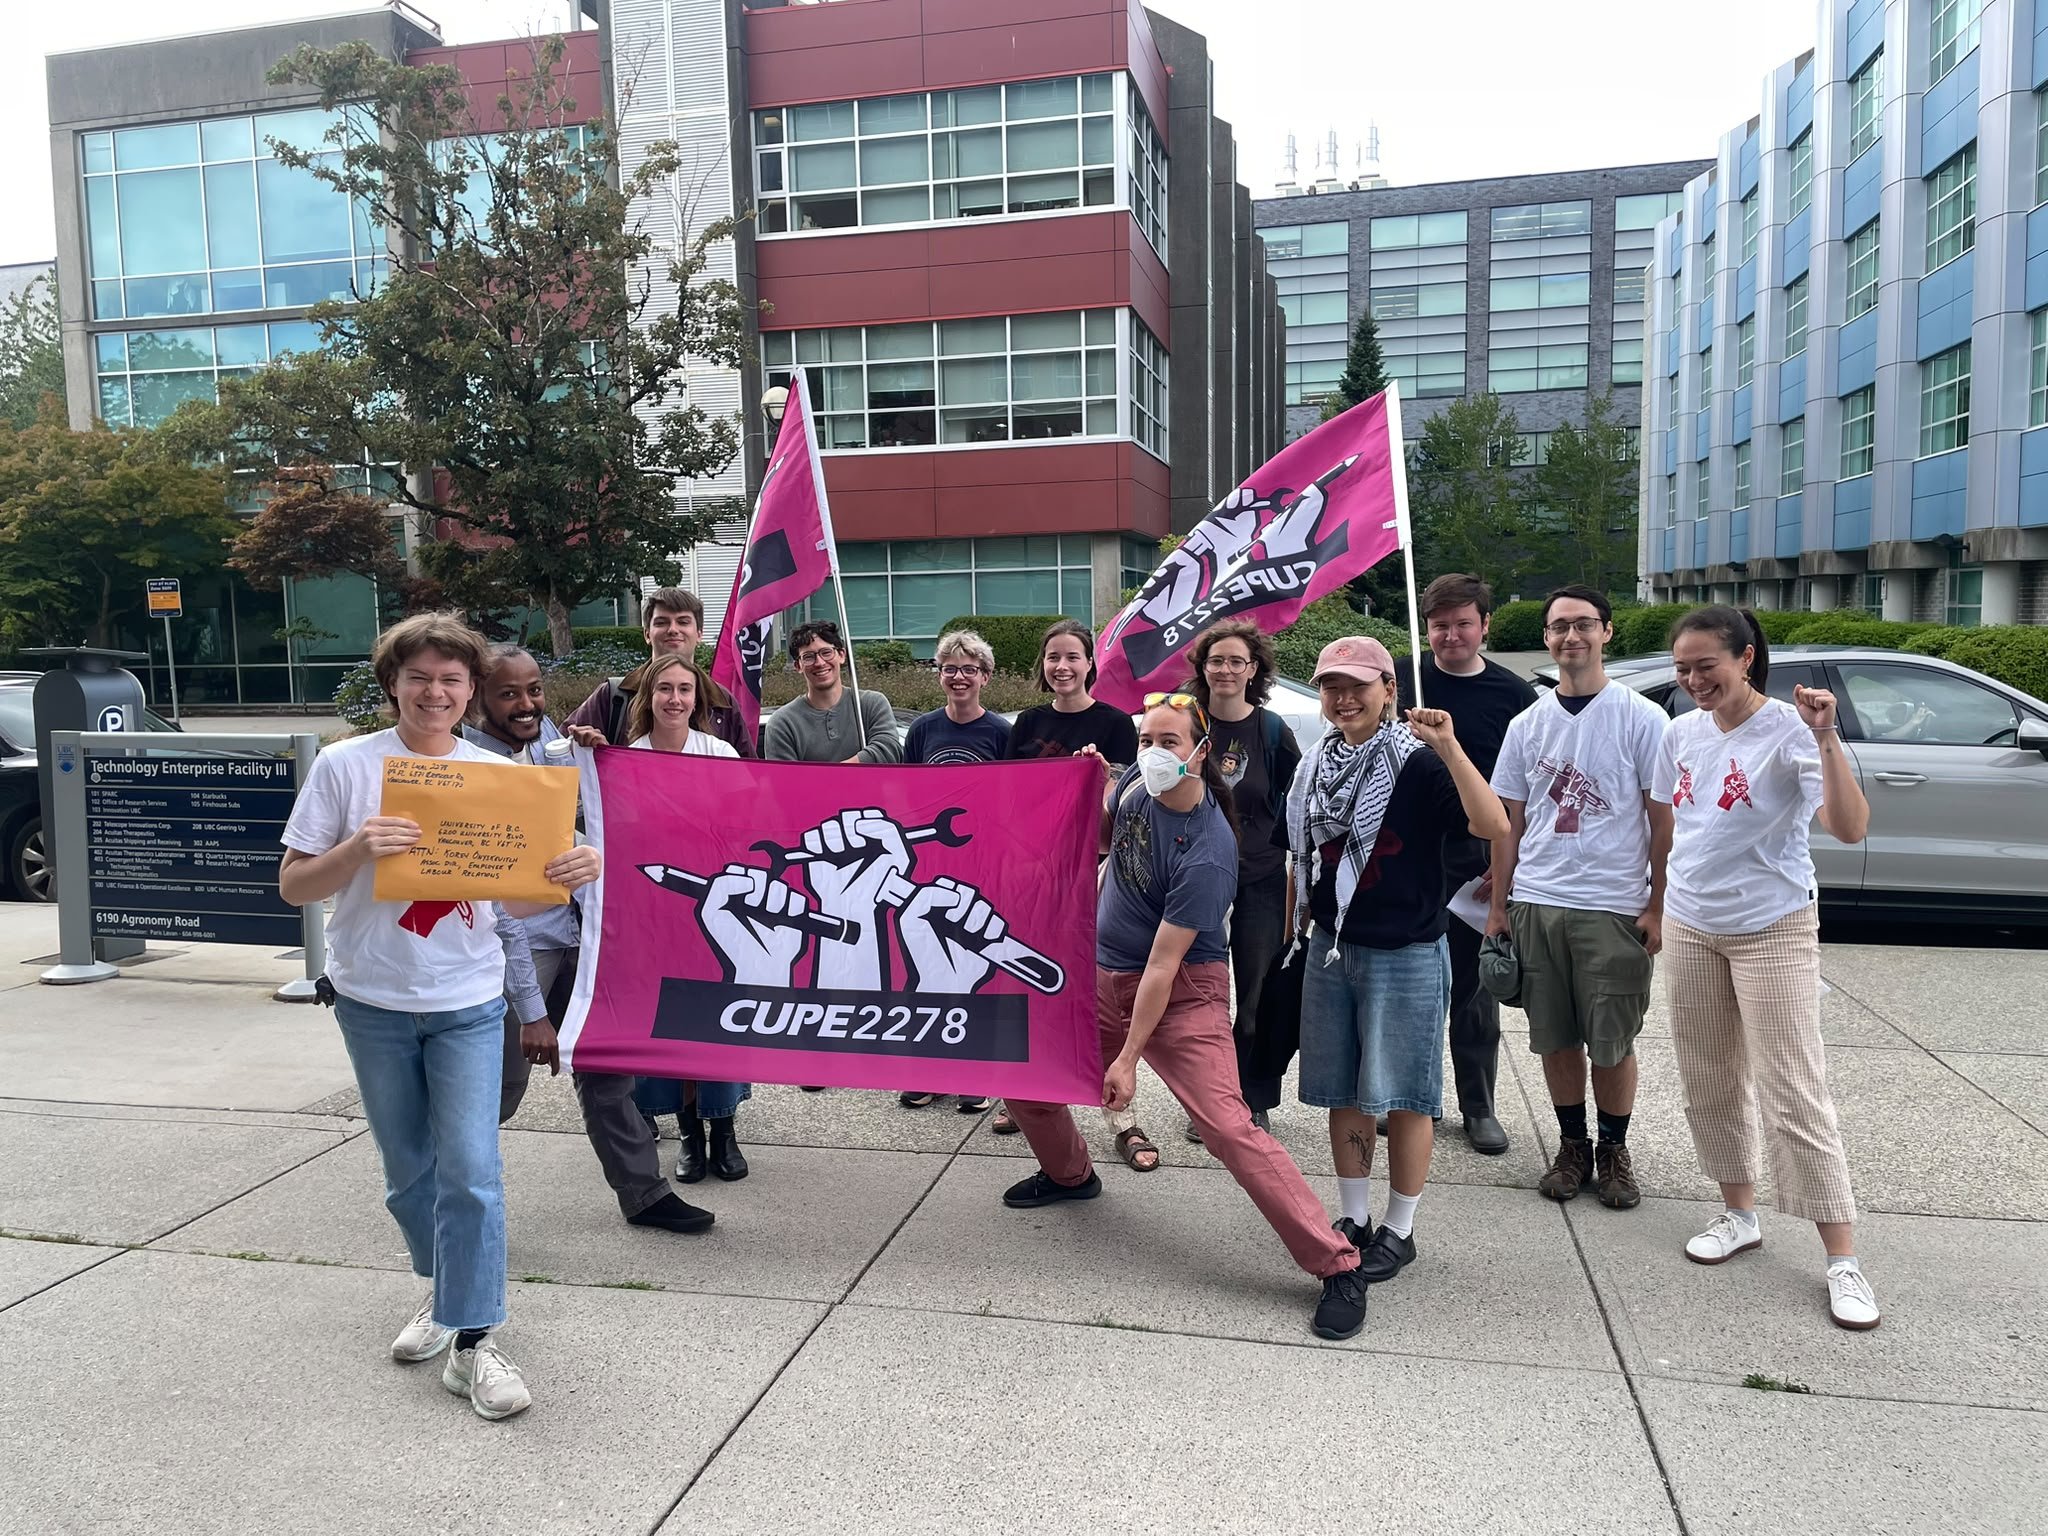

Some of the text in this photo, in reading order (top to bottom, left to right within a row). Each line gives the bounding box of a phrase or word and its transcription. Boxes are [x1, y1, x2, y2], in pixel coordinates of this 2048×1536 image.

[106, 713, 122, 732] P
[90, 760, 287, 779] Technology Enterprise Facility III
[440, 820, 485, 830] UNIVERSITY
[461, 869, 500, 879] RELATIONS
[96, 913, 200, 928] 6190 Agronomy Road
[720, 999, 968, 1044] CUPE2278
